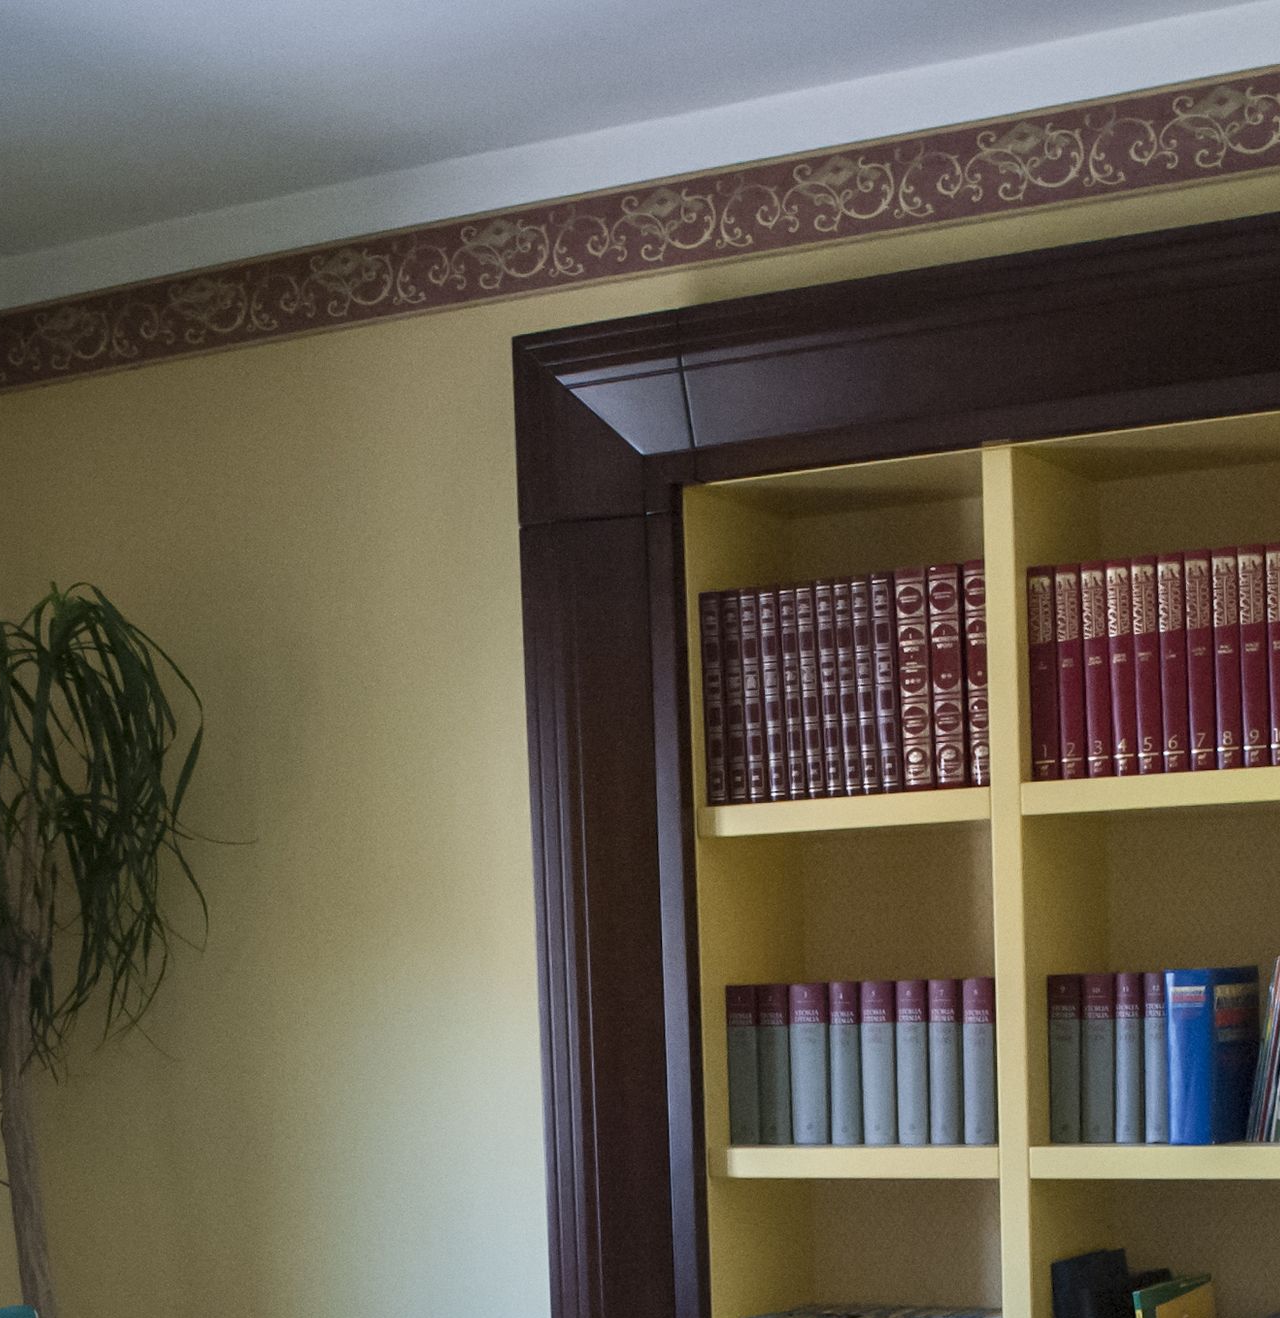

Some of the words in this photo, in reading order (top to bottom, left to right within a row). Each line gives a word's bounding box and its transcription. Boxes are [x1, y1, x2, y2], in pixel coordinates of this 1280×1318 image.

[1169, 734, 1178, 749] 6
[1196, 733, 1206, 747] 7
[1223, 731, 1232, 745] 8
[1249, 729, 1259, 744] 9
[1066, 742, 1075, 755] 2
[1094, 740, 1103, 754] 3
[1117, 738, 1127, 752] 4
[1143, 737, 1152, 751] 5
